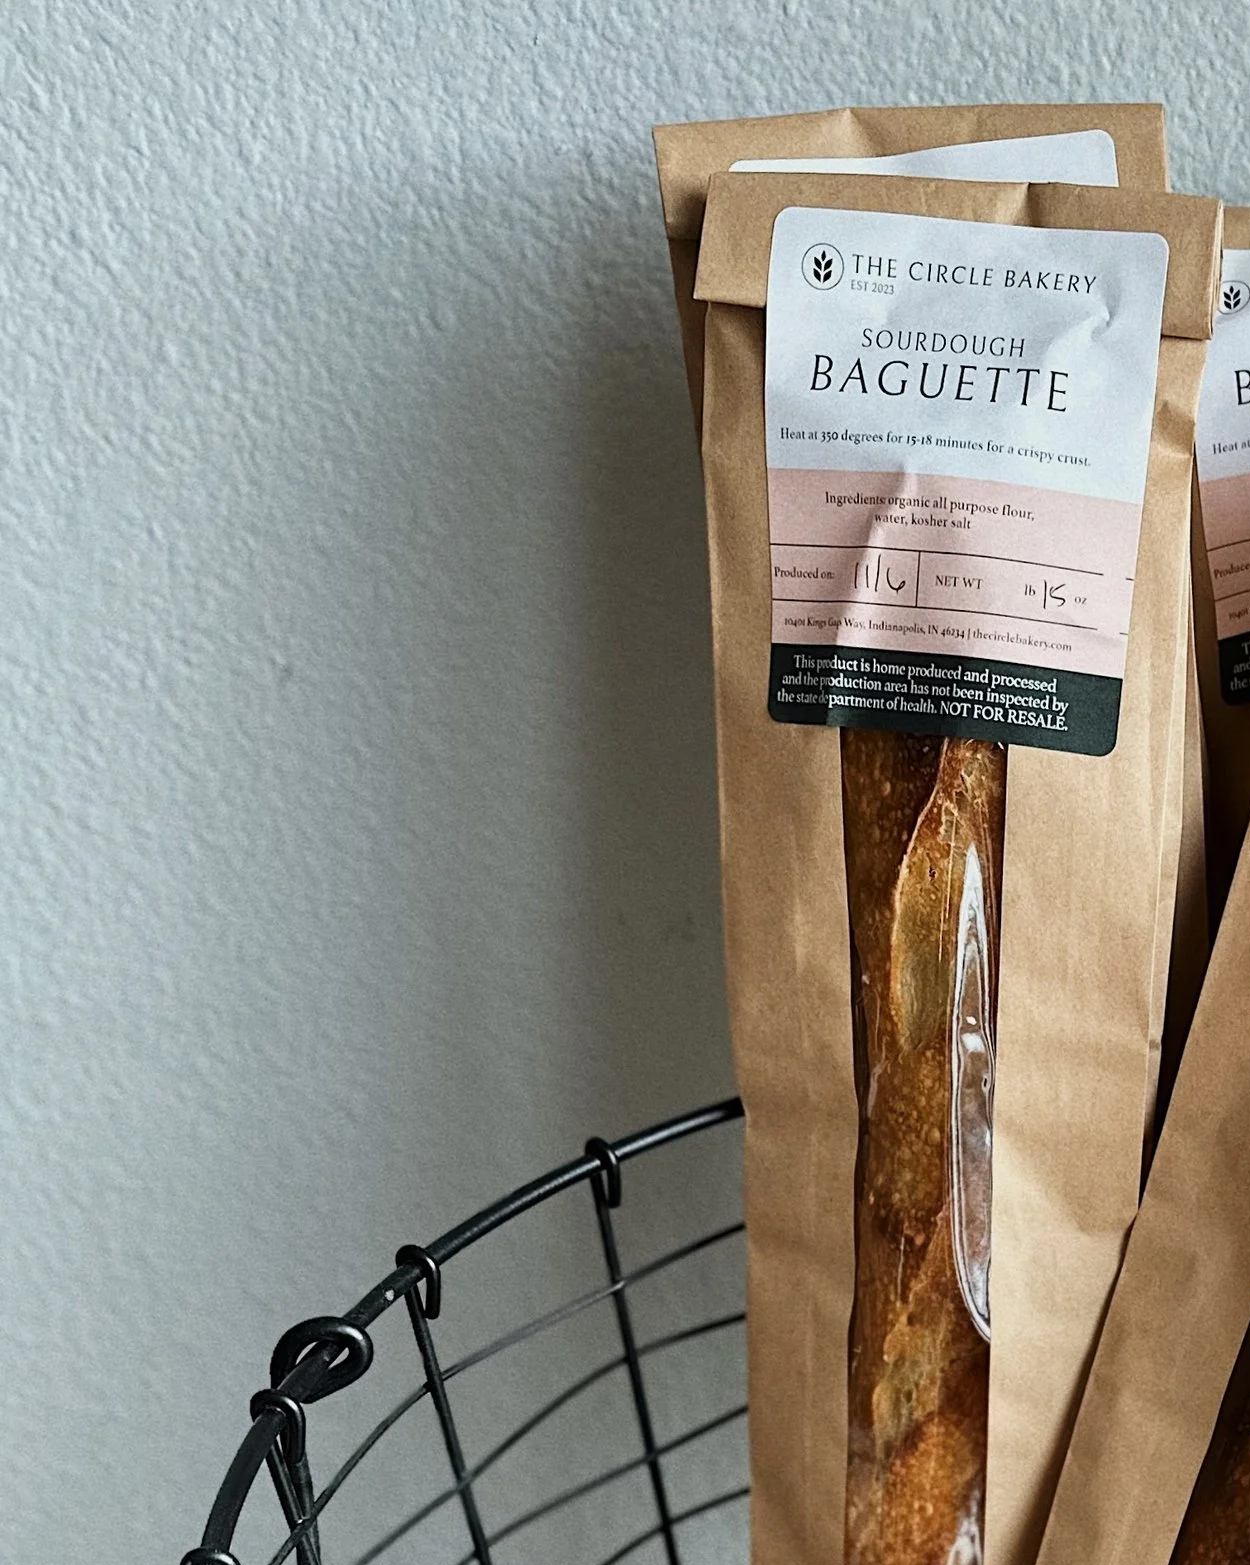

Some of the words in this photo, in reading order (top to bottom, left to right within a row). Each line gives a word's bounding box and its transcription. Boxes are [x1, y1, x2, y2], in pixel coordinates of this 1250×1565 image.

[852, 253, 896, 278] THE
[908, 261, 993, 286] CIRCLE
[1004, 269, 1096, 293] BAKERY
[850, 279, 868, 291] EST
[871, 282, 894, 295] 2023
[861, 328, 1024, 357] SOURDOUGH
[810, 354, 1068, 412] BAGUETTE
[780, 426, 805, 440] Heat
[807, 430, 817, 440] at
[820, 430, 838, 442] 350
[840, 428, 883, 445] degrees
[886, 431, 902, 443] for
[906, 434, 932, 446] 15-18
[935, 436, 983, 450] minutes
[986, 439, 1004, 453] for
[1007, 446, 1013, 454] a
[1017, 448, 1052, 462] crispy
[1057, 455, 1091, 466] crust.
[1212, 441, 1238, 454] Heat
[1240, 439, 1250, 448] at
[875, 511, 908, 525] water,
[910, 513, 948, 527] kosher
[950, 516, 970, 529] salt
[887, 495, 930, 509] organic
[932, 496, 947, 509] all
[949, 500, 998, 515] purpose
[1001, 503, 1034, 521] flour,
[773, 565, 818, 579] Produced
[853, 554, 906, 594] 11/6
[935, 574, 959, 587] NET
[962, 576, 982, 589] WT
[1024, 583, 1035, 595] lb
[1042, 579, 1066, 609] 15
[1073, 596, 1088, 605] oz
[793, 654, 814, 668] This
[816, 656, 858, 672] product
[860, 658, 870, 672] is
[872, 659, 905, 675] home
[907, 665, 961, 680] produced
[963, 670, 988, 683] and
[990, 673, 1057, 693] processed
[781, 671, 802, 685] and
[803, 672, 818, 685] the
[820, 673, 881, 690] production
[883, 681, 907, 692] area
[910, 679, 929, 694] has
[931, 685, 950, 696] not
[952, 683, 983, 700] been
[986, 687, 1049, 709] inspected
[1051, 695, 1069, 714] by
